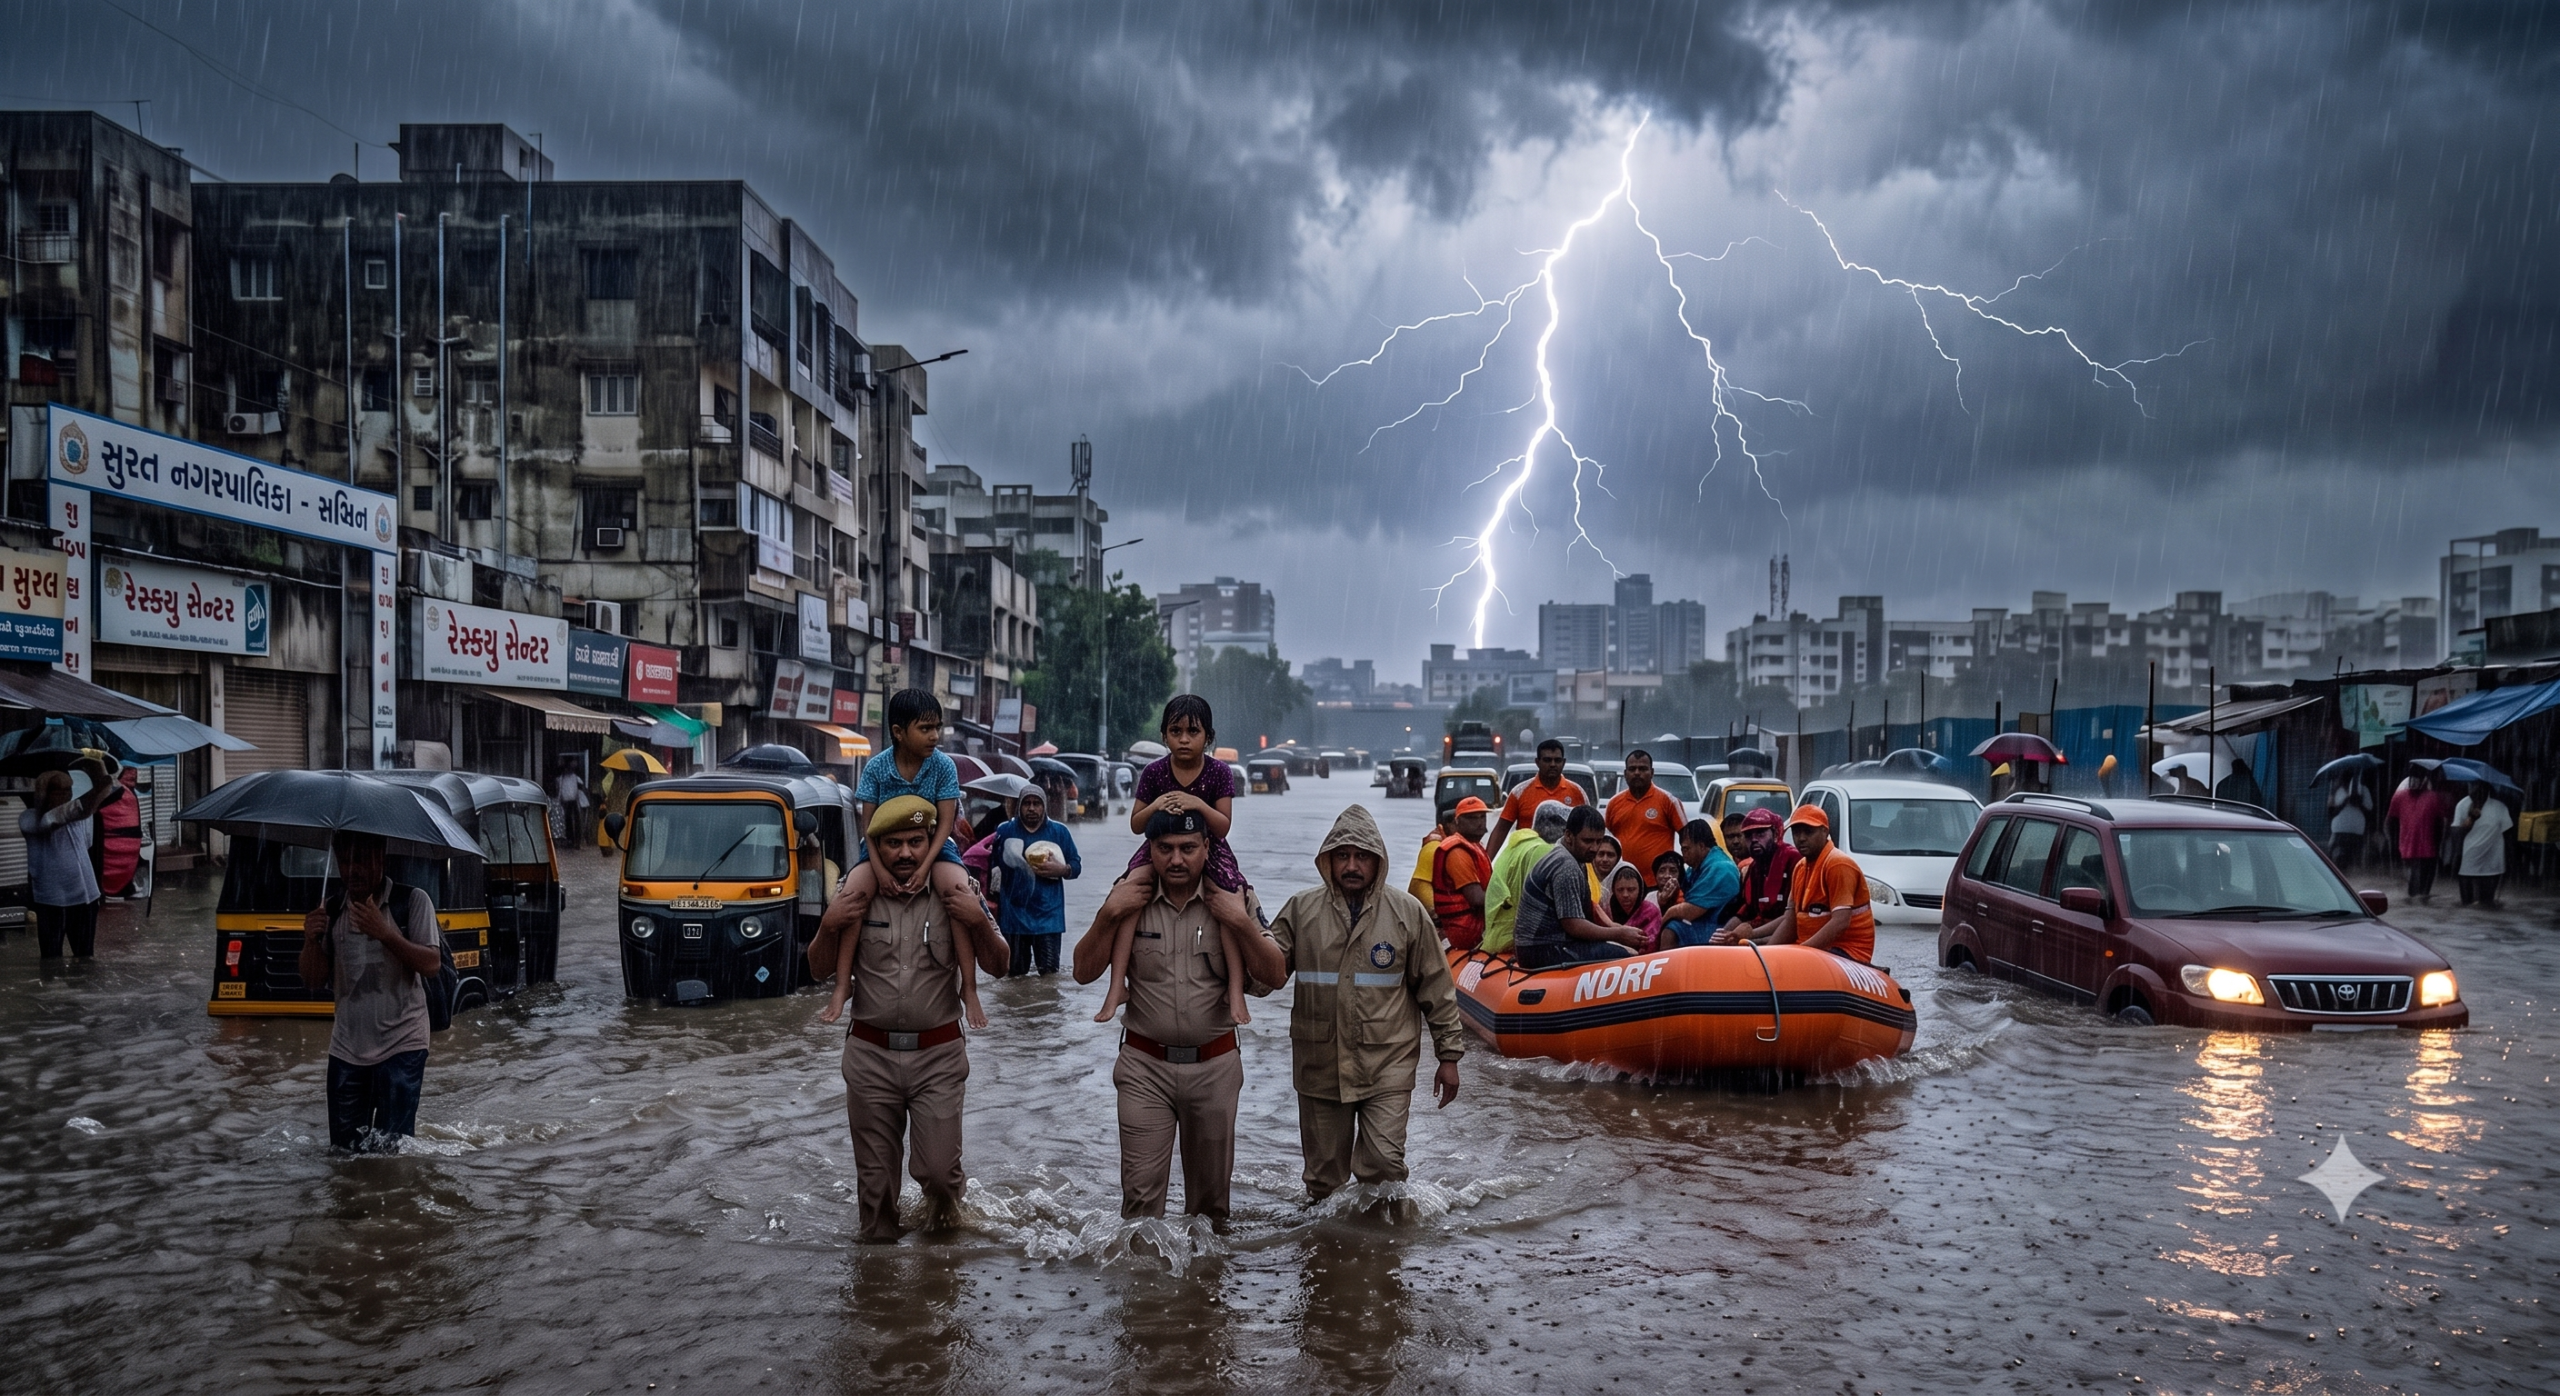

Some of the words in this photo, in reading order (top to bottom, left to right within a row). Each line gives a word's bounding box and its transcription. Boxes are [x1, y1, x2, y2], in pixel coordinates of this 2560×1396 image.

[101, 440, 159, 490] સુરત
[170, 461, 292, 514] નગરપાલિકા
[186, 581, 235, 622] સેન્ટર
[505, 618, 549, 664] સેન્ટર
[1573, 957, 1669, 1003] NDRF
